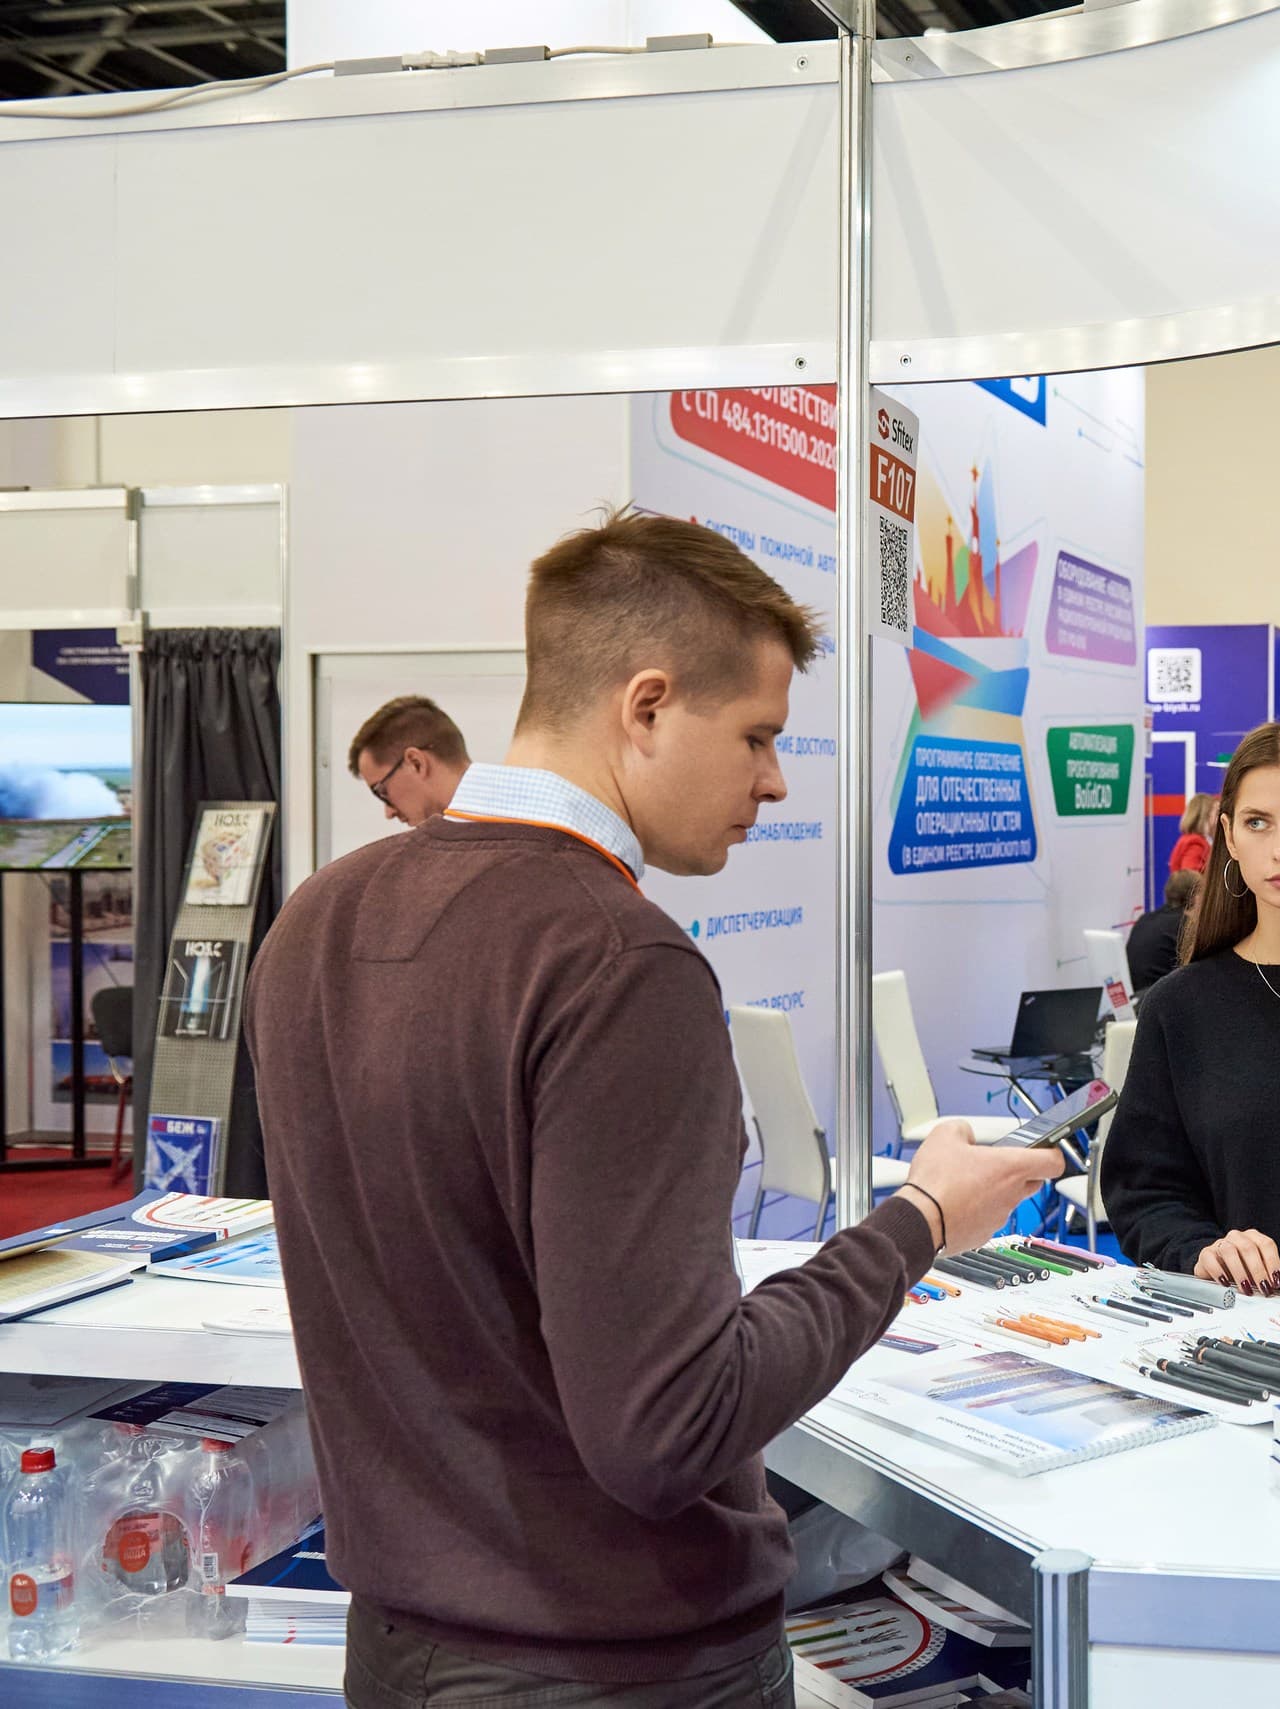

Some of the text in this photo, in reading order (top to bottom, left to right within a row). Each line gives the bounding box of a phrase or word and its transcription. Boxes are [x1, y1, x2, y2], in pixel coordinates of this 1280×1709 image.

[695, 390, 719, 423] СП
[892, 418, 914, 454] Sfitex
[877, 453, 913, 514] F107
[761, 535, 814, 566] ПОЖАРНОЙ
[795, 737, 836, 756] ДОСТУПО
[915, 747, 973, 771] ПРОГРАММНОЕ
[915, 776, 1021, 807] ДЛЯ ОТЕЧЕСТВЕННЫХ
[746, 822, 822, 843] ЕОНАБЛЮДЕНИЕ
[915, 811, 1022, 837] ОПЕРАЦИОННЫХ СИСТЕМ
[705, 906, 803, 941] ДИСПЕТЧЕРИЗАЦИЯ
